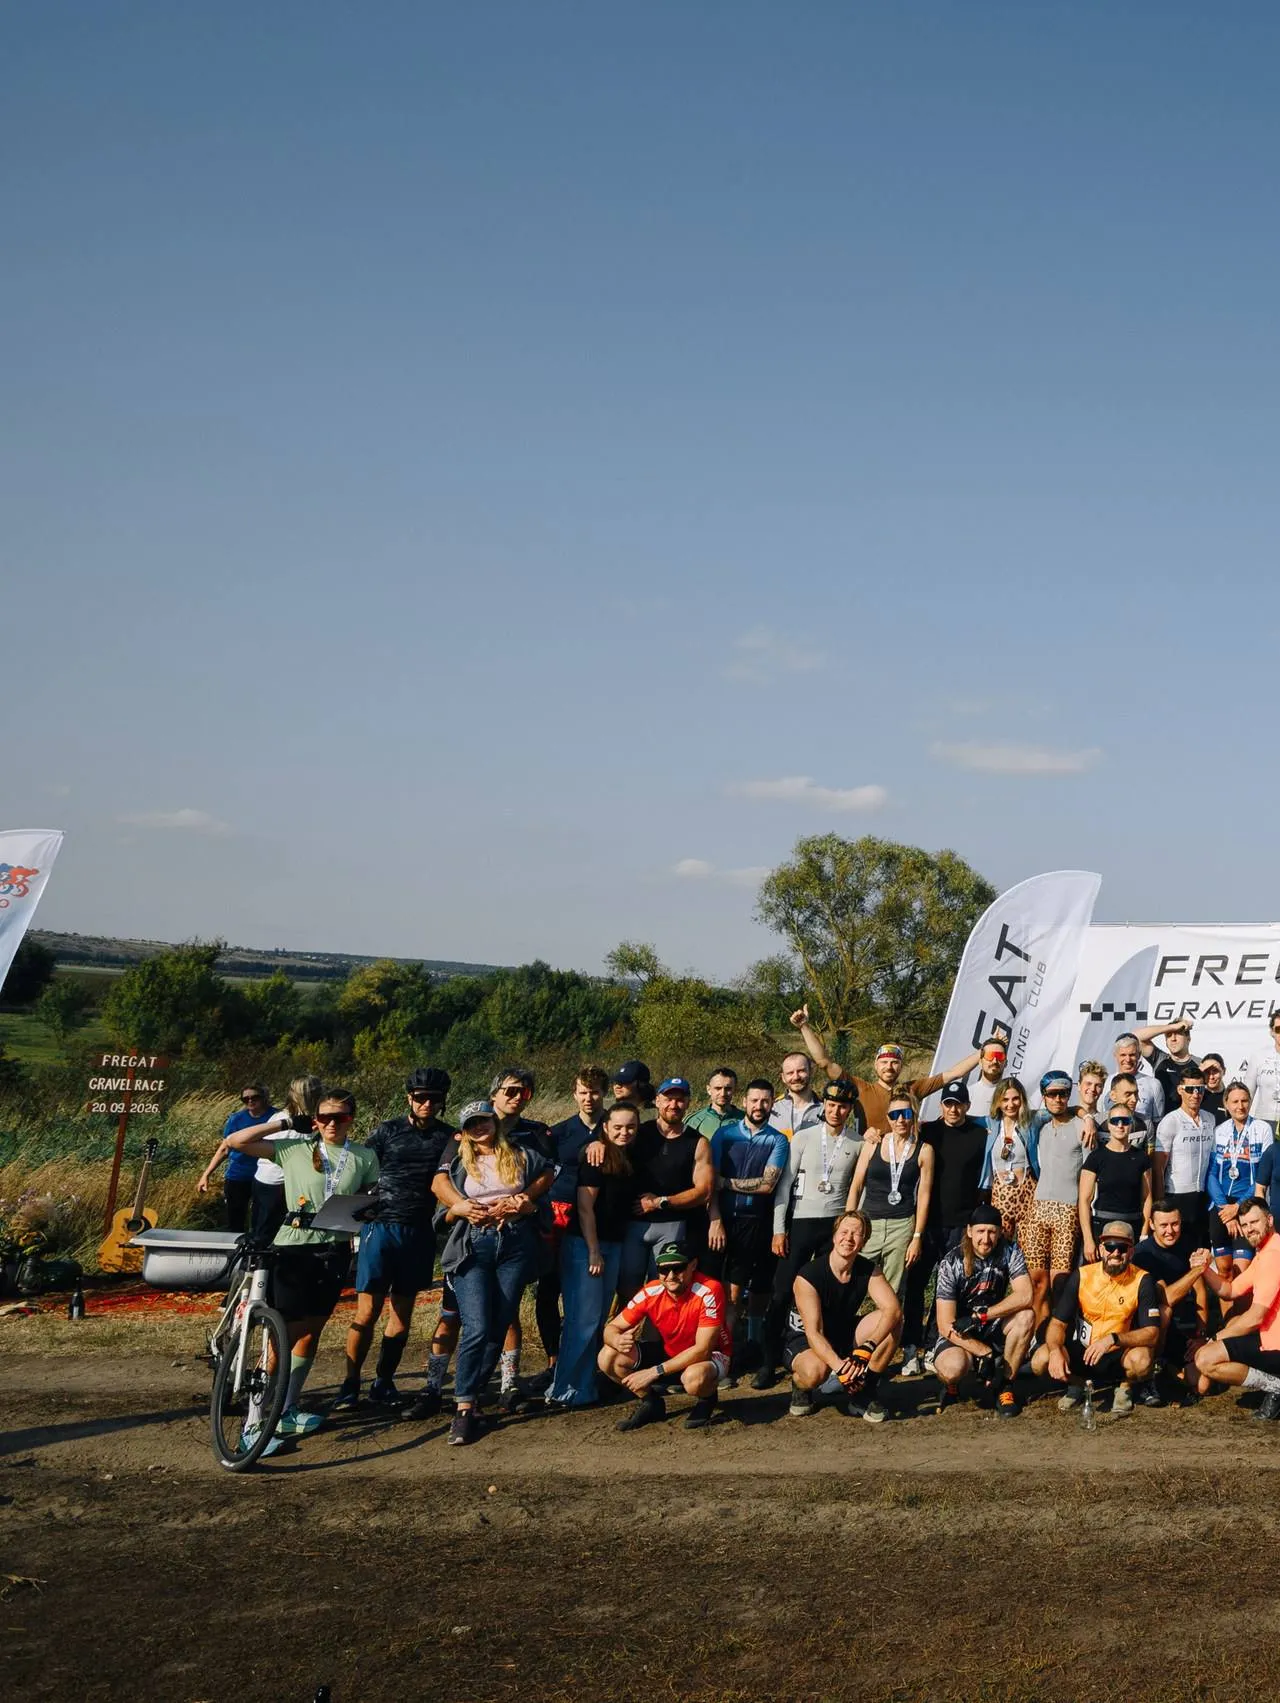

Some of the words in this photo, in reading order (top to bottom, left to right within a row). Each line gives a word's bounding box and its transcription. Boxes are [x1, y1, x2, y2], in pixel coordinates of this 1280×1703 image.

[1154, 1000, 1276, 1020] GRAVEL
[1010, 1026, 1030, 1079] ACING
[1027, 961, 1047, 1008] CLUB
[102, 1054, 158, 1068] FREGAT
[88, 1077, 132, 1091] GRAVEL
[134, 1079, 165, 1091] RACE
[1080, 1325, 1087, 1340] 6
